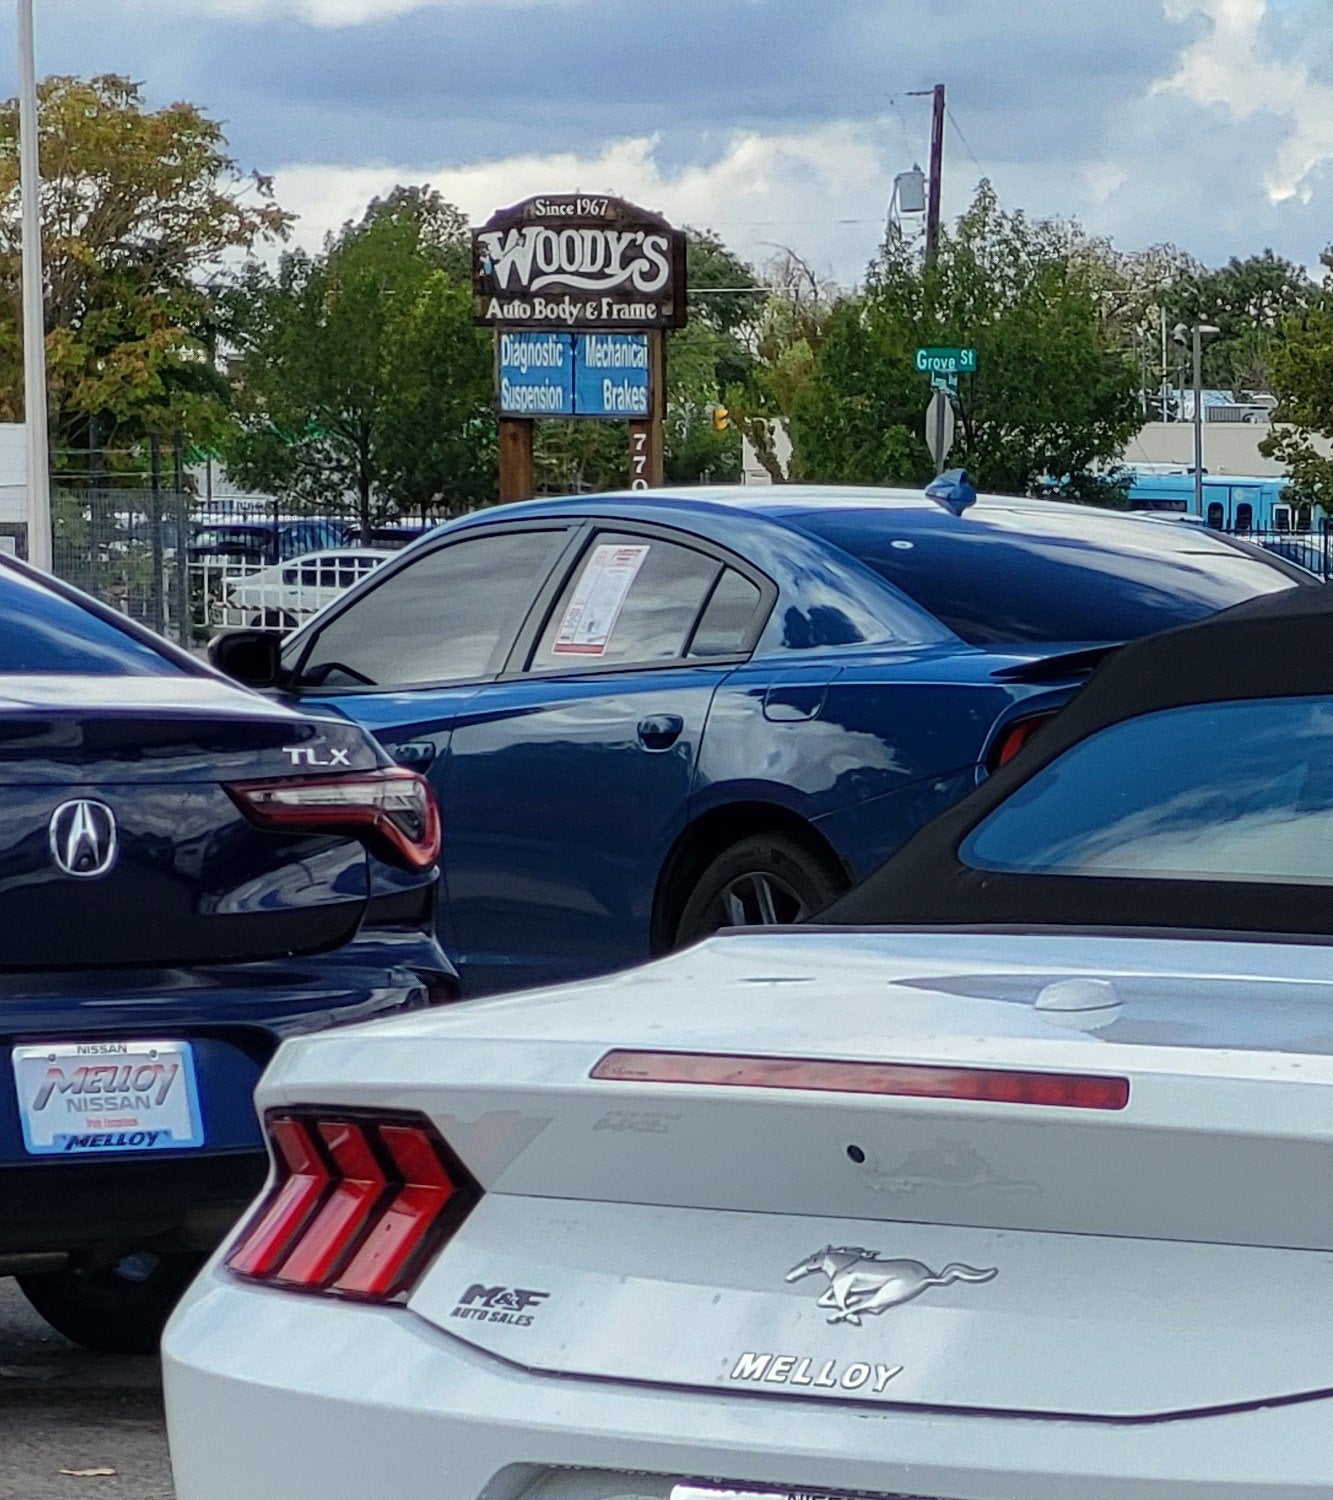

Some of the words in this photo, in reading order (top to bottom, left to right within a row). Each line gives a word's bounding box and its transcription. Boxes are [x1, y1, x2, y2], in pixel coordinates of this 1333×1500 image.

[534, 199, 574, 216] Since
[577, 199, 609, 216] 1967
[478, 226, 669, 292] WOODY'S
[485, 298, 531, 319] Auto
[533, 296, 582, 325] Body
[585, 303, 598, 319] &
[601, 298, 657, 320] Frame
[501, 334, 563, 374] Diagnostic
[585, 335, 648, 368] Mechanical
[916, 349, 956, 370] Grove
[960, 349, 974, 366] St
[501, 377, 563, 412] Suspension
[603, 378, 647, 411] Brakes
[282, 747, 352, 766] TLX
[77, 1044, 128, 1055] NISSAN
[32, 1063, 178, 1111] MELLOY
[67, 1094, 151, 1113] NISSAN
[65, 1131, 159, 1150] MELLOY
[459, 1284, 550, 1311] M&F
[450, 1306, 489, 1321] AUTO
[488, 1311, 535, 1327] SALES
[730, 1352, 904, 1392] MELLOY
